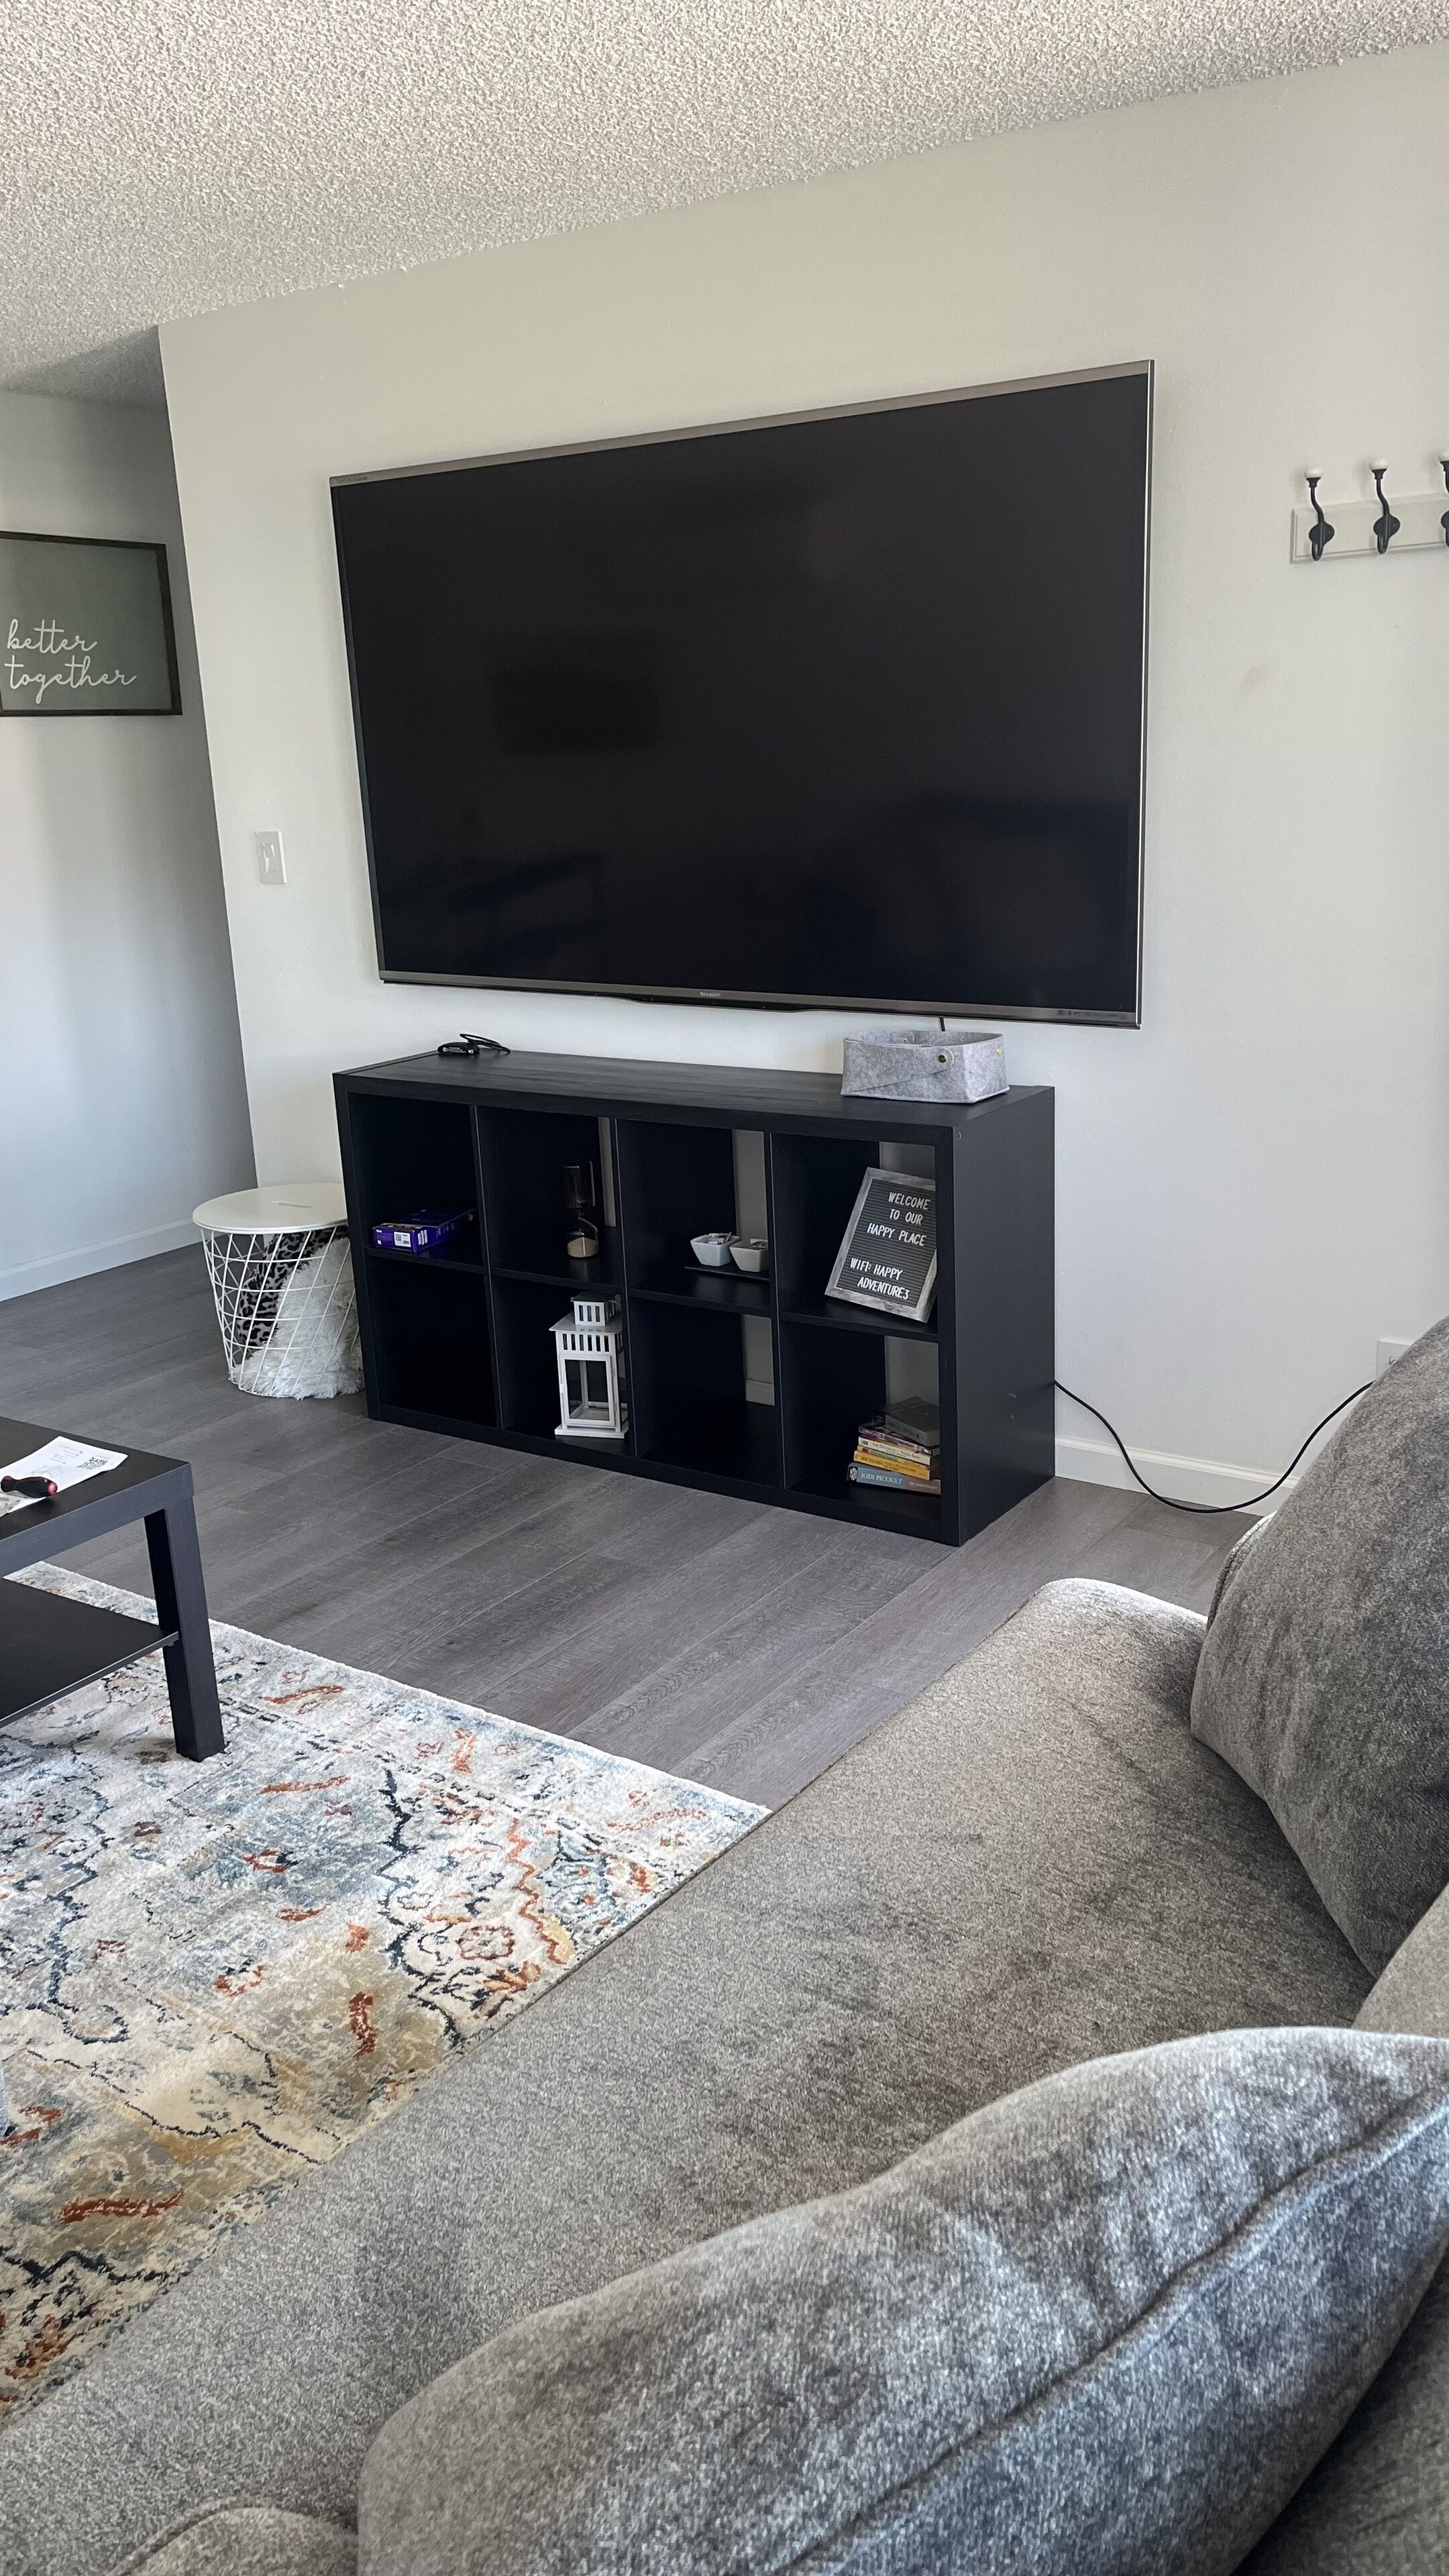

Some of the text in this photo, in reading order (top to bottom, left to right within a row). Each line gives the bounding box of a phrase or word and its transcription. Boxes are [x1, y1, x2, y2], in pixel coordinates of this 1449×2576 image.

[7, 619, 97, 654] better
[4, 655, 137, 704] together
[888, 1192, 930, 1210] WELCOME
[889, 1208, 923, 1226] TO OUR
[867, 1223, 927, 1246] HAPPY PLACE
[850, 1257, 904, 1281] WIFI: HAPPY
[857, 1277, 910, 1300] ADVENTURE3
[860, 1472, 904, 1485] JODI PICOULT
